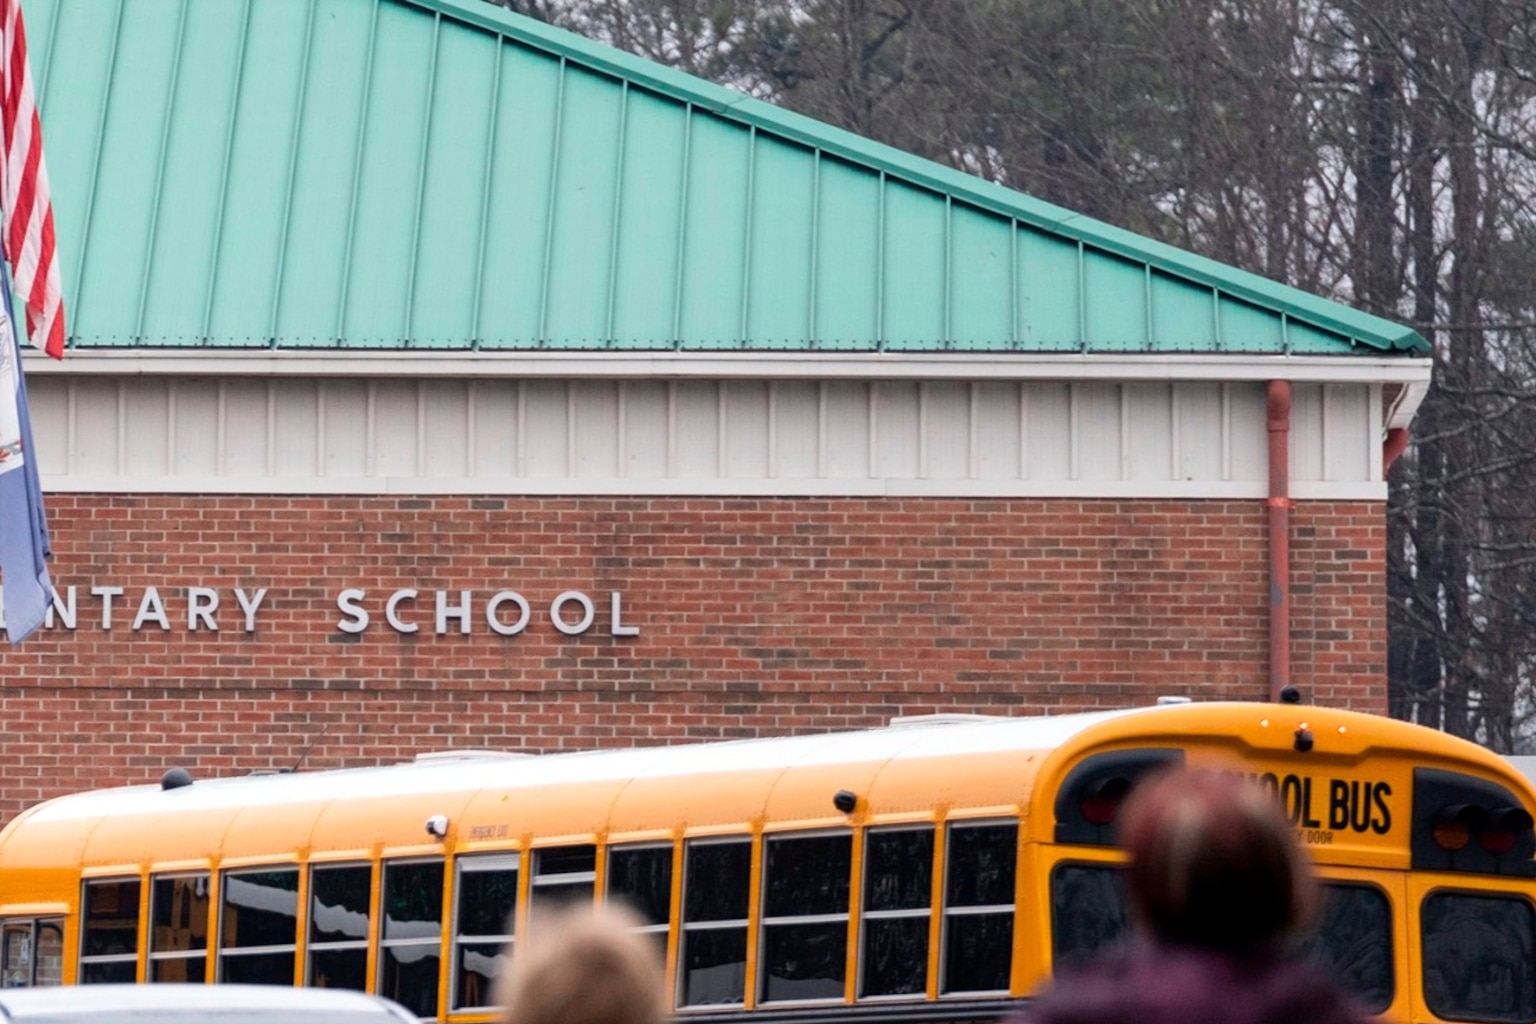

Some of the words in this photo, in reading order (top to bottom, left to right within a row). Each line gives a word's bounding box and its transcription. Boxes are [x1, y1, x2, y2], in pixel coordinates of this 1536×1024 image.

[336, 588, 640, 635] SCHOOL
[1329, 779, 1392, 835] BUS
[1307, 830, 1334, 844] DOOR
